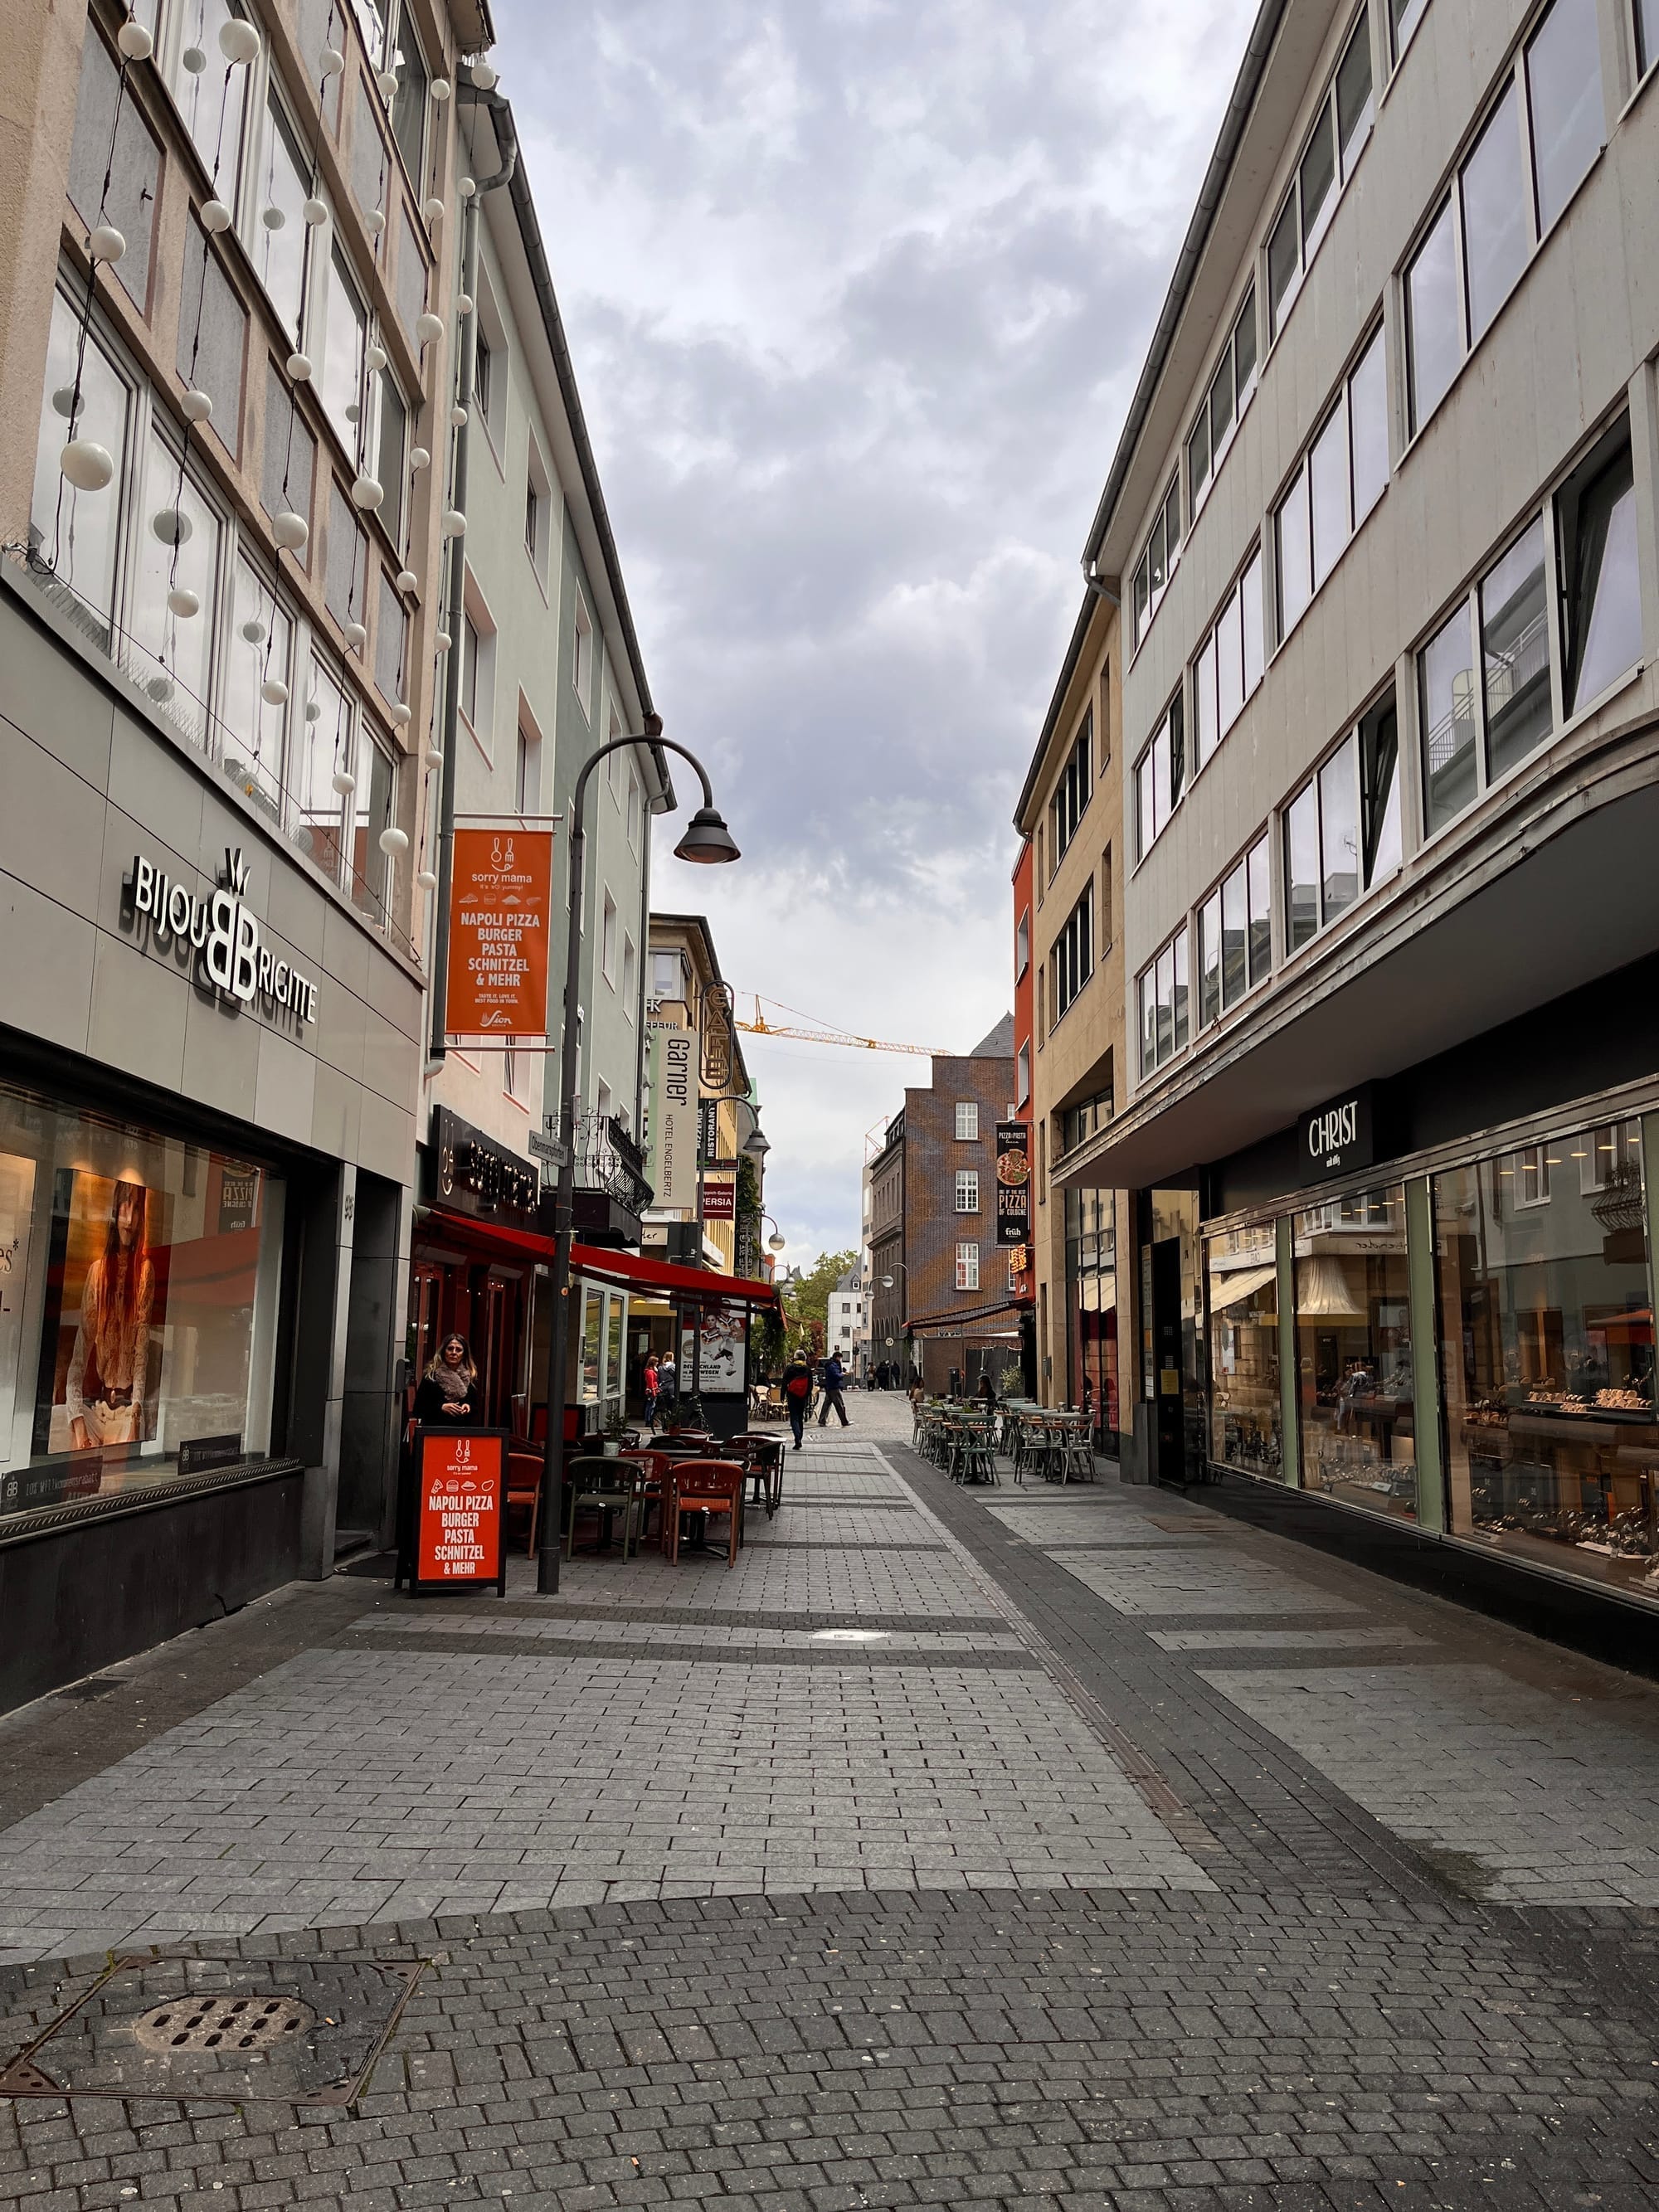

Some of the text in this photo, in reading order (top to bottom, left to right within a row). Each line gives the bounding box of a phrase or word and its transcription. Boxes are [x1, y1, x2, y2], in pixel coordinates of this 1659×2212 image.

[471, 873, 533, 884] sorry mama
[134, 856, 207, 948] BIJOU
[460, 912, 540, 927] NAPOLI PIZZA
[477, 928, 523, 942] BURGER
[481, 943, 518, 956] PASTA
[468, 958, 530, 972] SCHNITZEL
[475, 973, 521, 987] & MEHR
[479, 1009, 513, 1028] Sion
[666, 1038, 690, 1106] Garner
[1308, 1101, 1358, 1157] CHRIST
[663, 1114, 673, 1197] HOTEL ENGELBERTZ
[999, 1194, 1027, 1208] PIZZA
[1005, 1228, 1021, 1236] früh
[428, 1495, 494, 1511] NAPOLI PIZZA
[441, 1512, 479, 1528] BURGER
[444, 1529, 475, 1544] PASTA
[434, 1545, 485, 1561] SCHNITZEL
[444, 1562, 475, 1575] & MEHR
